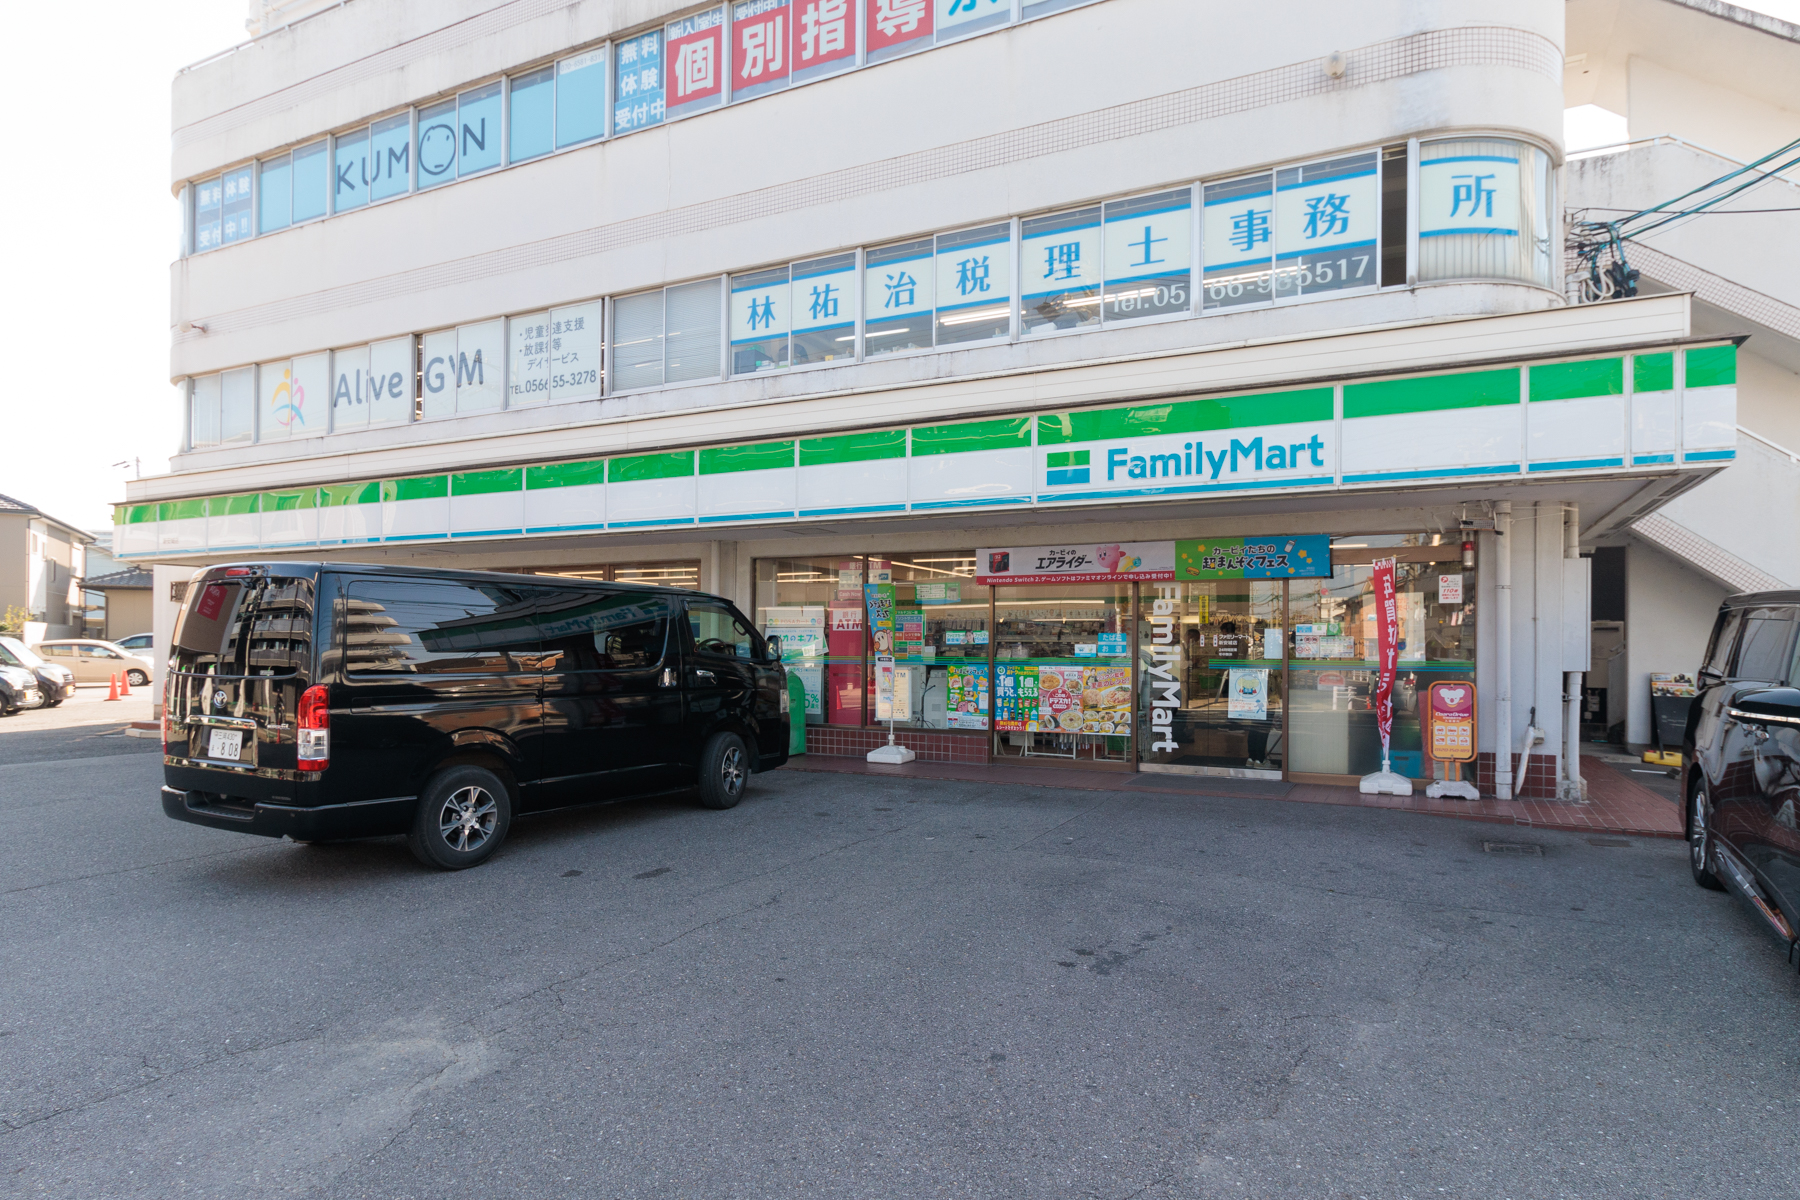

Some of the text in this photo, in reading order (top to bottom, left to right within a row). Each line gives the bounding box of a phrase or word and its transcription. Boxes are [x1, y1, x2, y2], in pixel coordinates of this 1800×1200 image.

[619, 33, 659, 66] 無料
[619, 67, 659, 98] 体験
[615, 99, 665, 131] 受付中
[336, 117, 486, 195] KUMON
[747, 173, 1498, 331] 林祐治税理士事務所
[334, 368, 404, 408] Alive
[1107, 433, 1325, 481] FamilyMart
[849, 561, 882, 570] 銀行TM
[1035, 554, 1094, 570] エアライダー
[1049, 549, 1077, 557] カービィの
[1202, 554, 1288, 570] 超まんぞくフェス
[836, 619, 862, 629] ATM
[1151, 581, 1181, 753] FamilyMart
